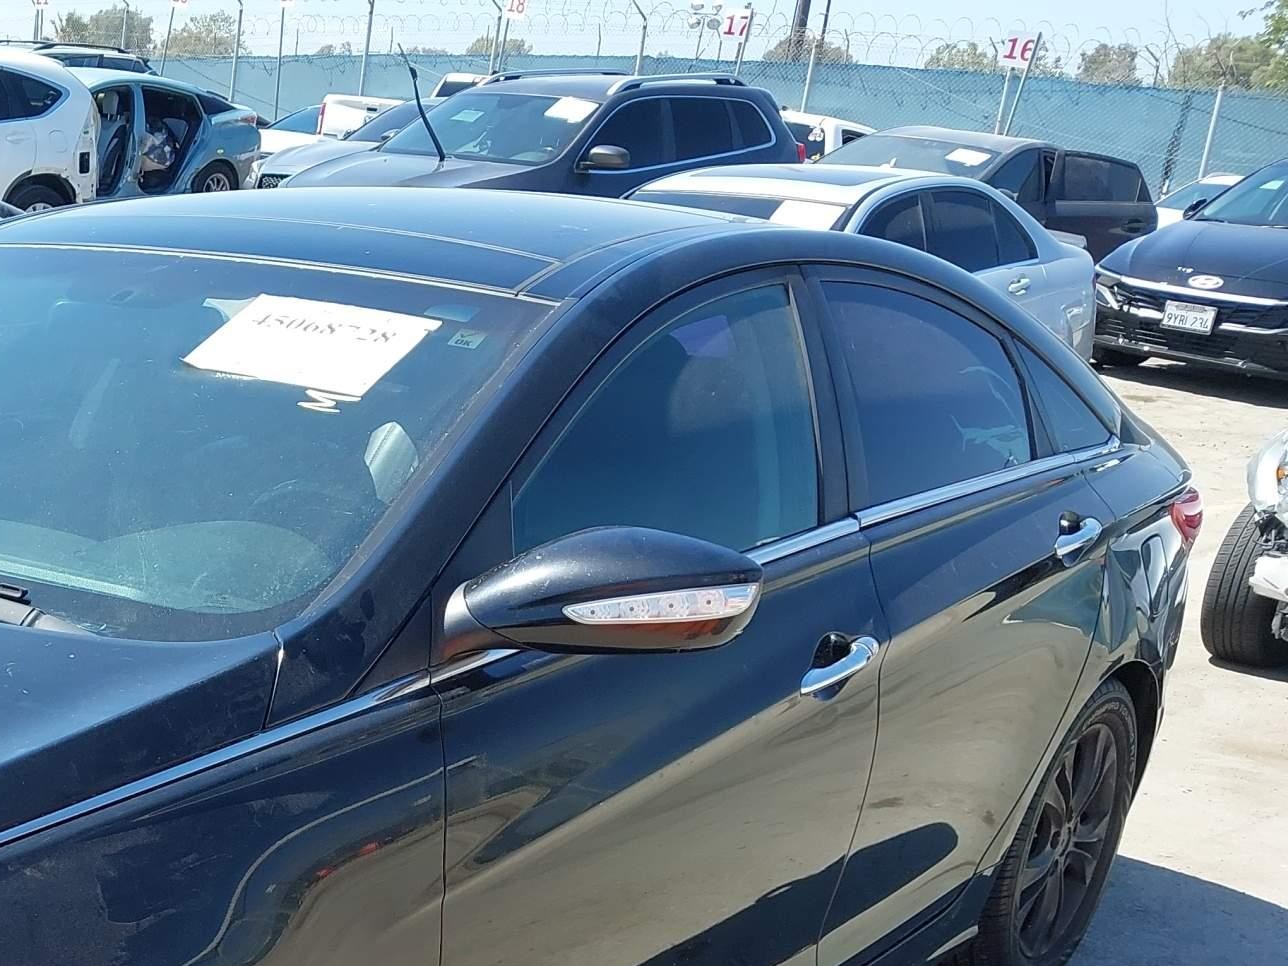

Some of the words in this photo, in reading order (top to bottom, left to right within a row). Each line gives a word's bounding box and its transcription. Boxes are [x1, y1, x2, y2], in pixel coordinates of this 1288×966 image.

[506, 0, 525, 14] 18
[723, 14, 750, 37] 17
[1003, 37, 1036, 61] 16
